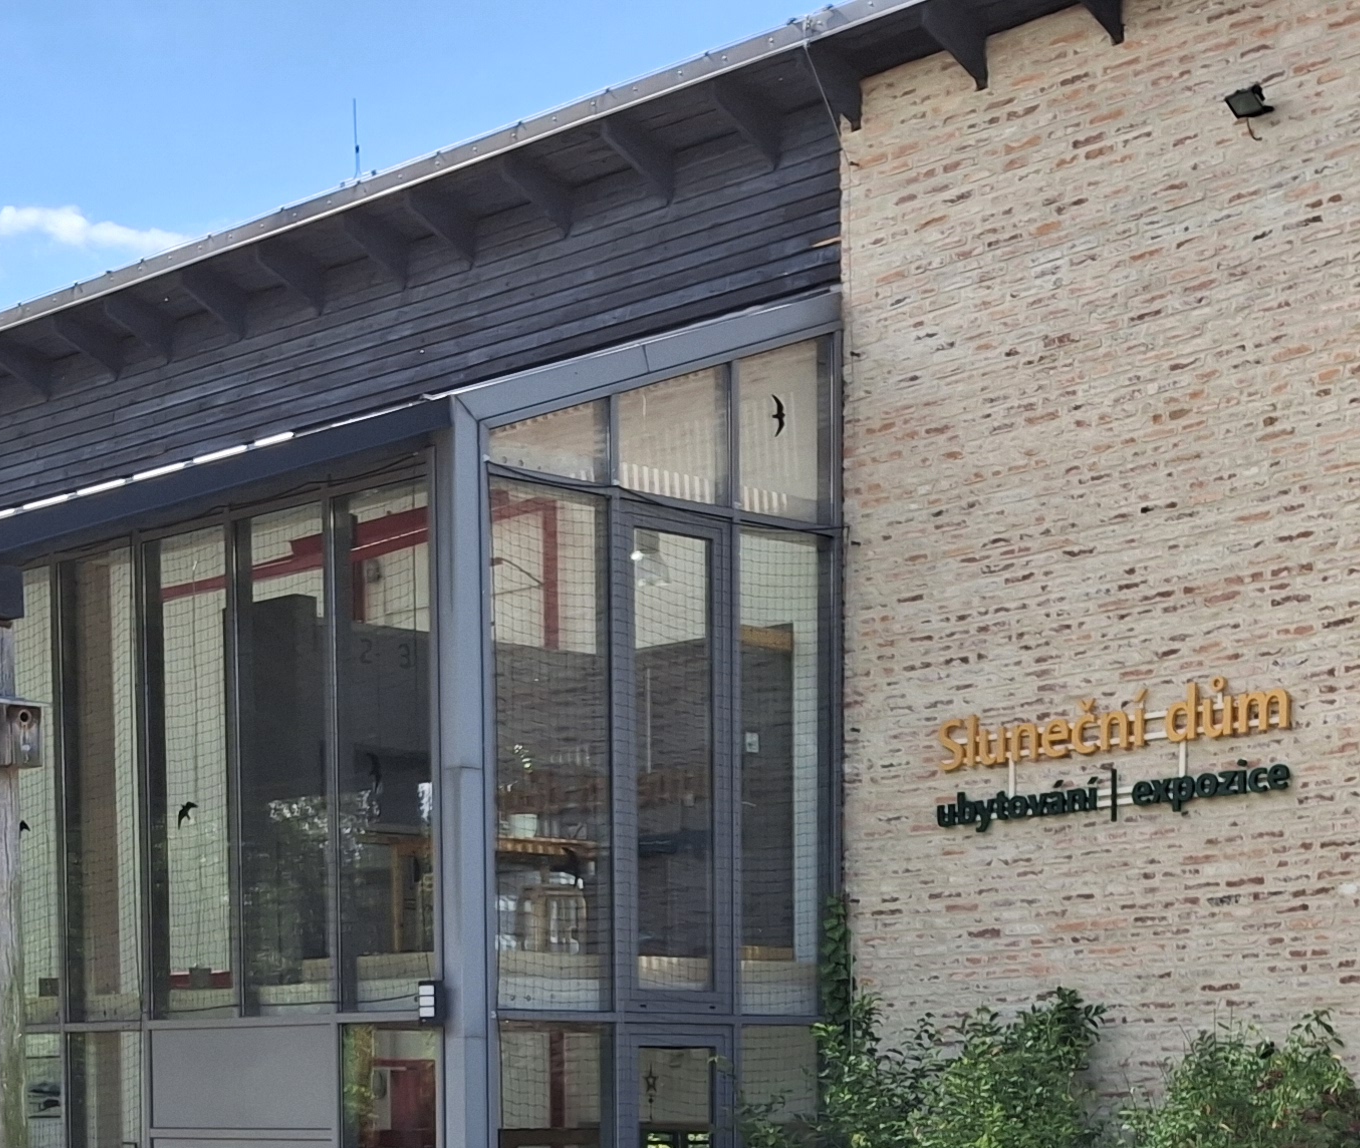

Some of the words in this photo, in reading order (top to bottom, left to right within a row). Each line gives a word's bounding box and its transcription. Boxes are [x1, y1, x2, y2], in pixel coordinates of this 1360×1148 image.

[938, 688, 1148, 773] Sluneční
[1165, 675, 1292, 743] dům
[937, 776, 1098, 832] ubytování
[1132, 758, 1291, 812] expozice
